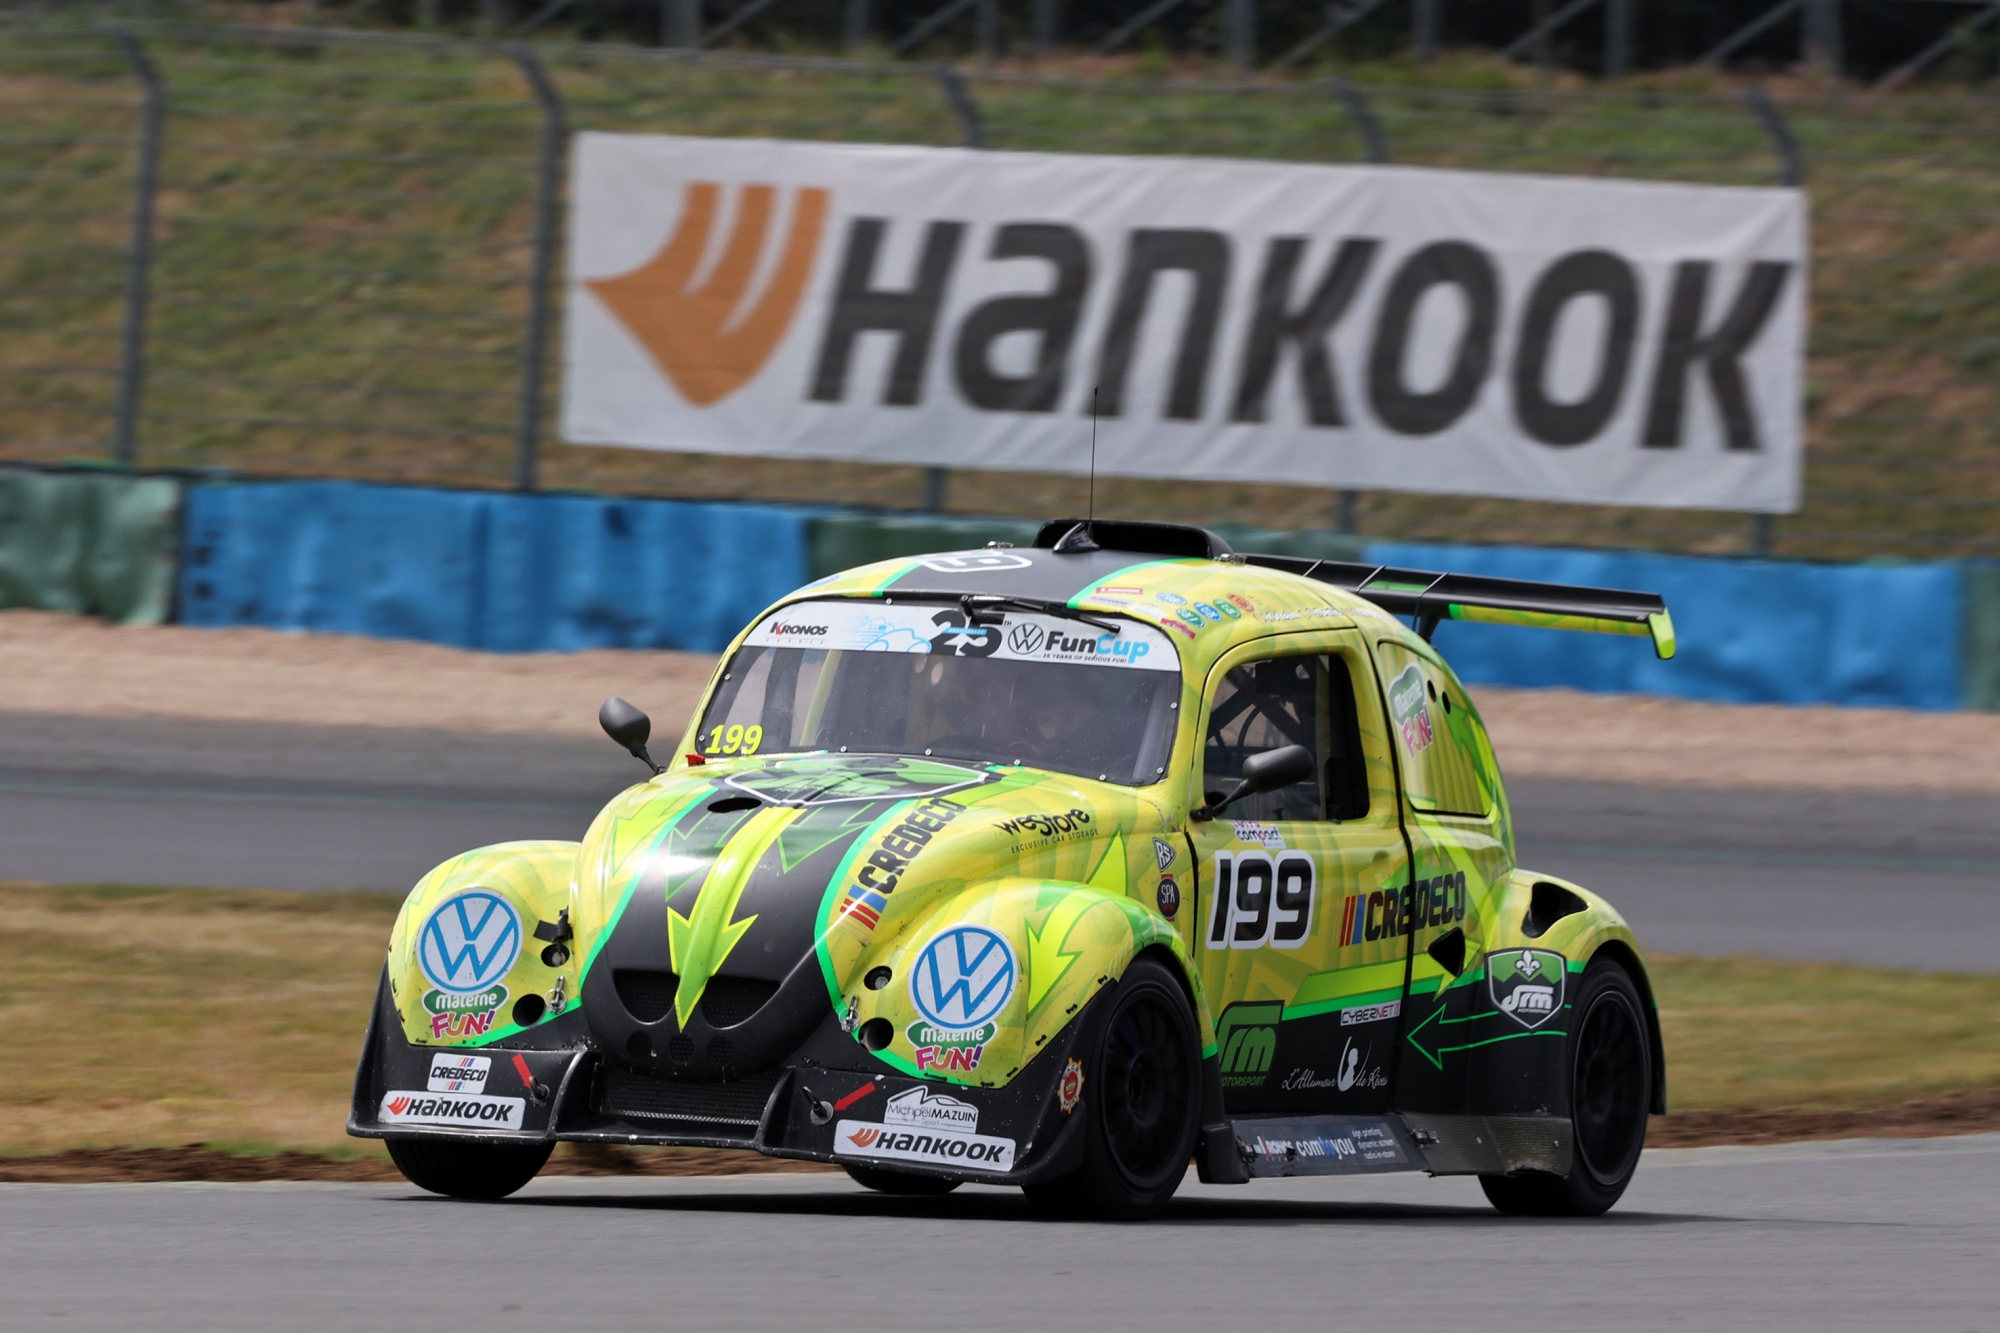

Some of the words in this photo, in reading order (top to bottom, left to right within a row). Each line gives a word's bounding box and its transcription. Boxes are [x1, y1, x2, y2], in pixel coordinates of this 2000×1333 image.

[769, 619, 829, 635] KRONOS
[704, 725, 763, 755] 199
[858, 798, 967, 894] CREDECO
[1011, 839, 1049, 854] EXCLUSIVE
[1051, 833, 1066, 845] CAR
[1068, 827, 1099, 842] STORAGE
[1161, 884, 1176, 904] SPA
[1210, 857, 1313, 942] 199
[1365, 871, 1466, 942] CREDECO
[432, 1009, 496, 1039] FUN!
[915, 1044, 984, 1072] FUN!
[431, 1066, 488, 1082] CREDECO
[1221, 1075, 1267, 1086] OTORSPORT
